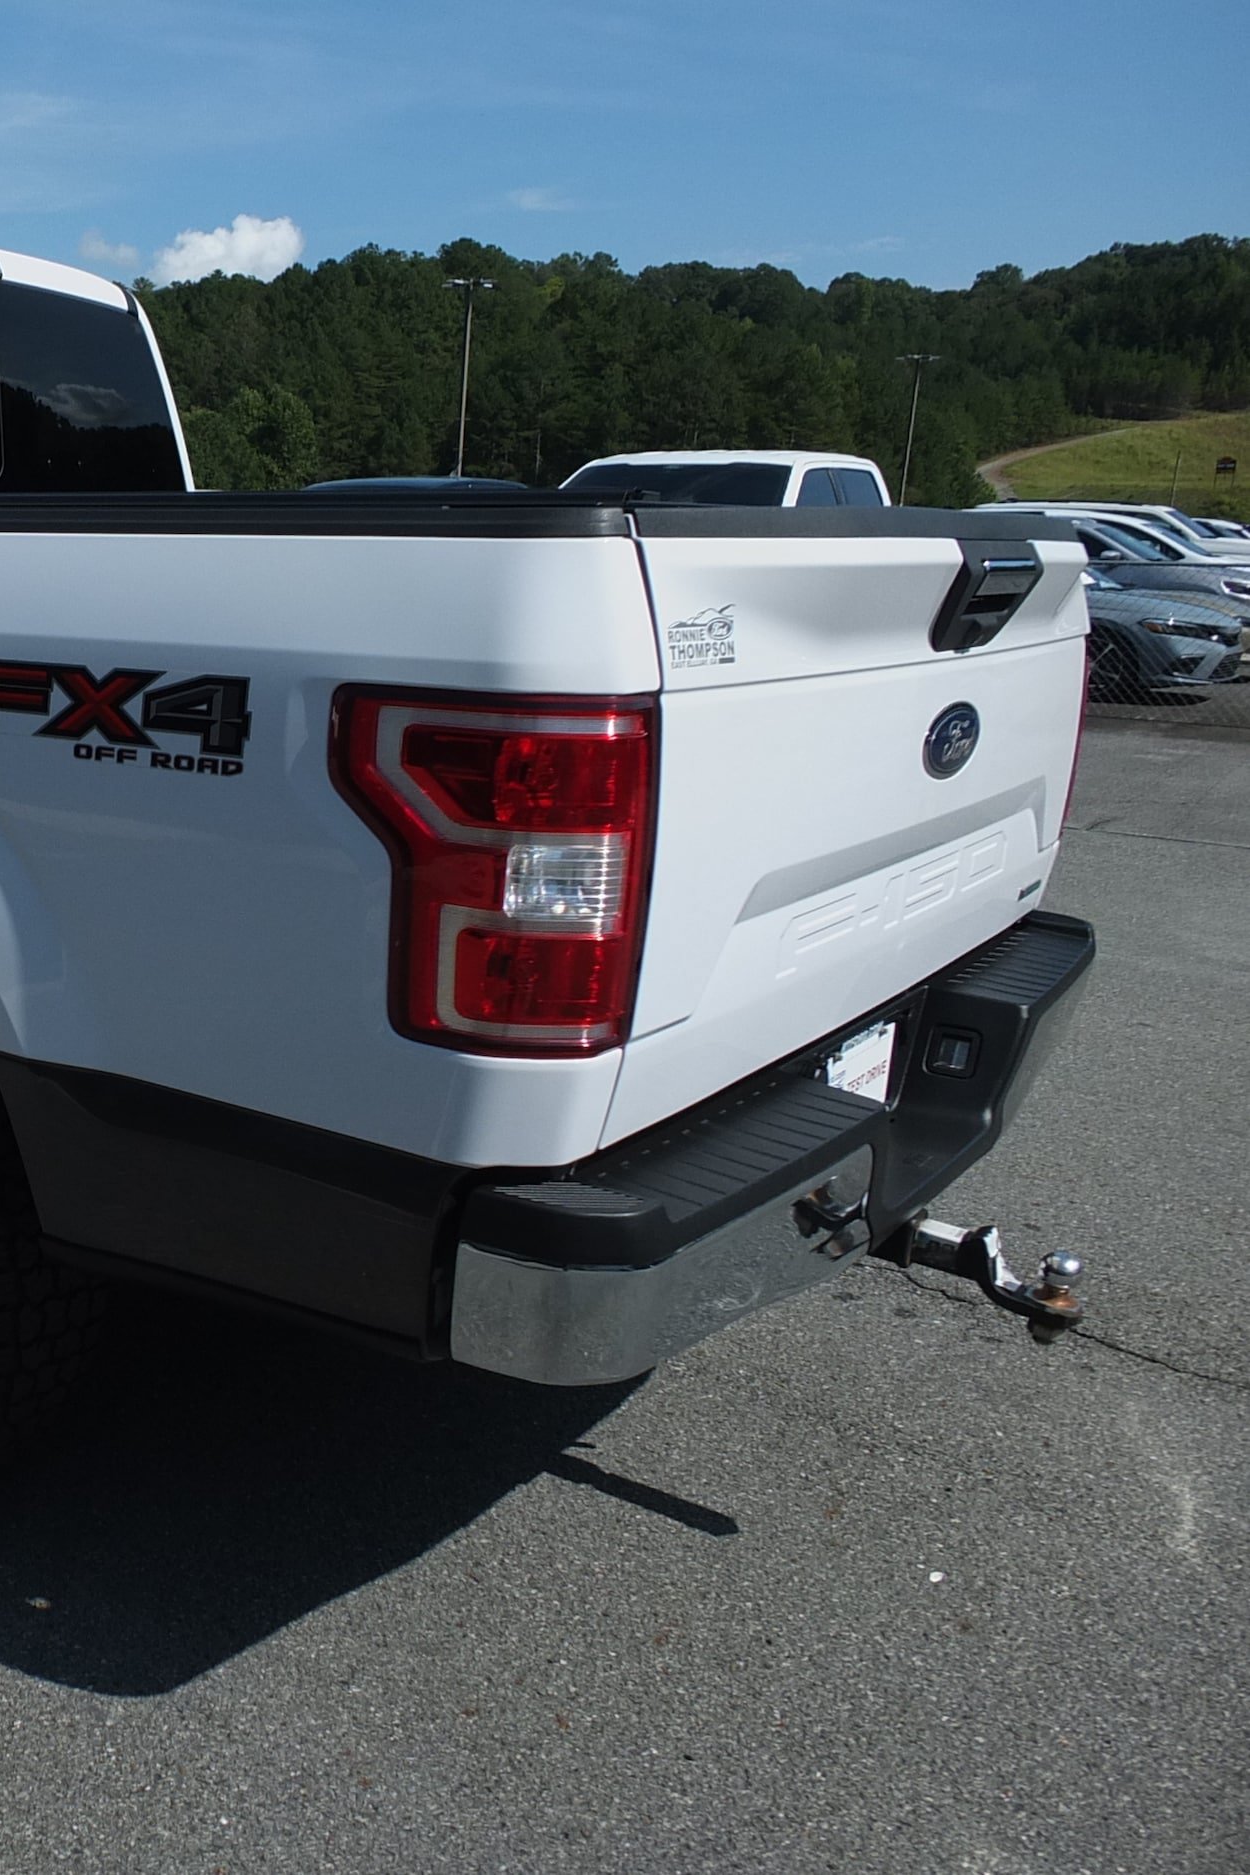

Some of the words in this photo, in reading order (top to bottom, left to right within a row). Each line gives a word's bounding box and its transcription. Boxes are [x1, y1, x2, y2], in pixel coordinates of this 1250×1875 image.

[668, 629, 706, 643] RONNIE
[669, 641, 735, 661] THOMPSON
[73, 743, 137, 764] OFF
[150, 751, 244, 777] ROAD
[775, 828, 1009, 981] F-150
[846, 1073, 866, 1093] TEST
[865, 1059, 888, 1085] DRIVE
